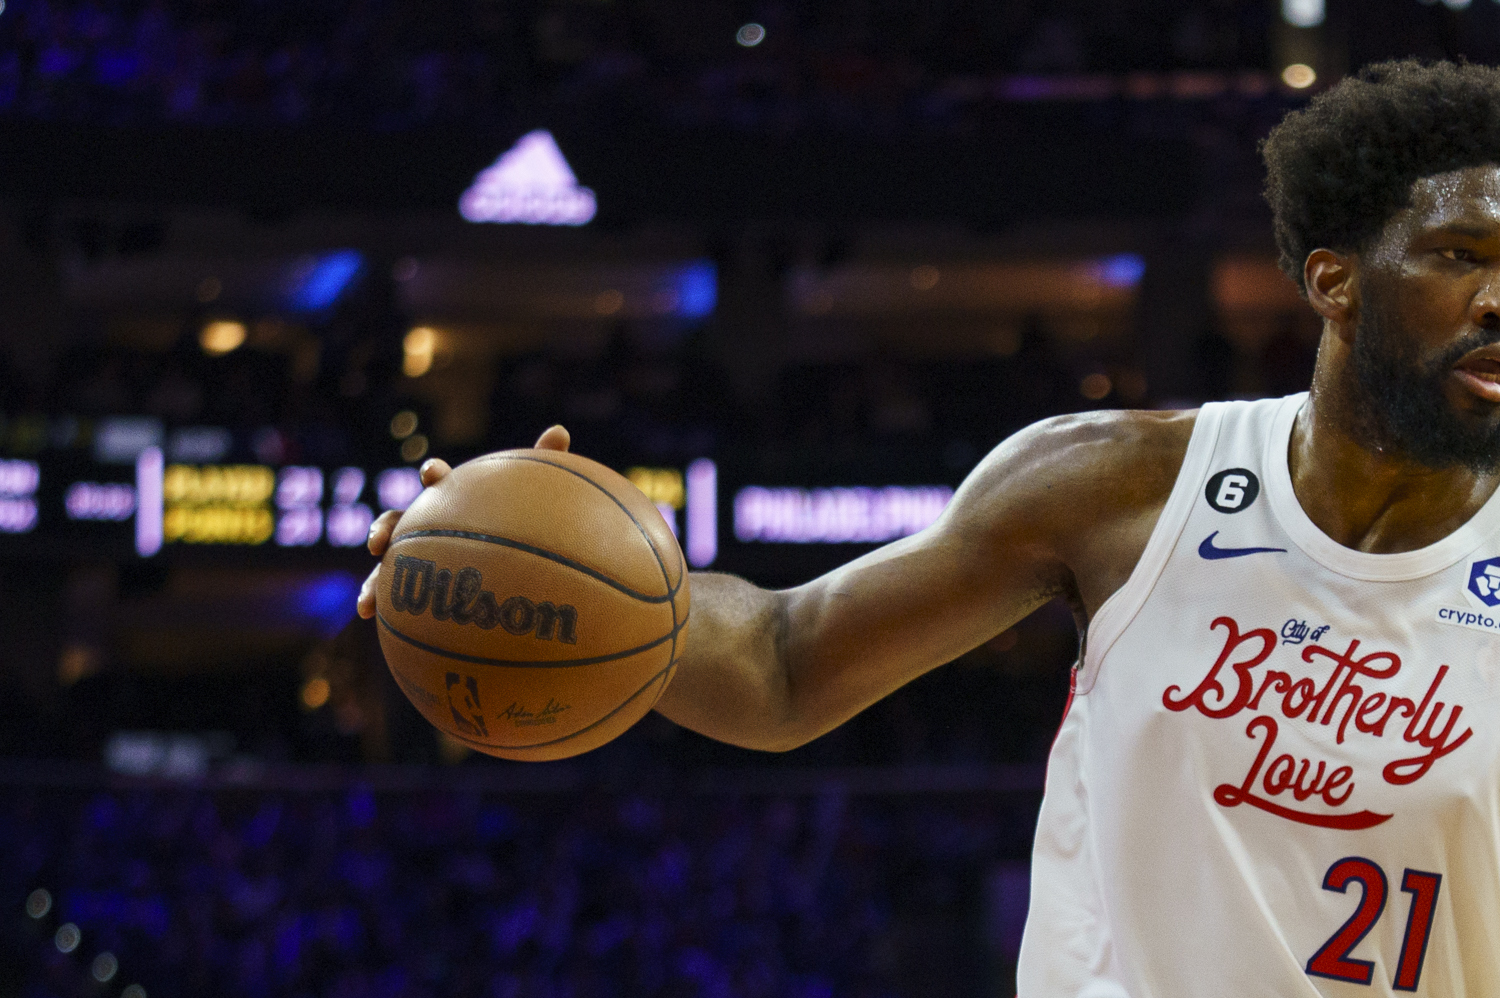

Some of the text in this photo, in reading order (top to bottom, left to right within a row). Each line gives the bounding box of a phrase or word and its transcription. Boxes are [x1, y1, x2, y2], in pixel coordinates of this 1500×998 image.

[1216, 474, 1248, 508] 6
[391, 555, 578, 645] Wilson
[1281, 618, 1330, 645] City of
[1162, 616, 1474, 785] Brotherly
[1213, 716, 1394, 830] Love
[1305, 856, 1442, 992] 21
